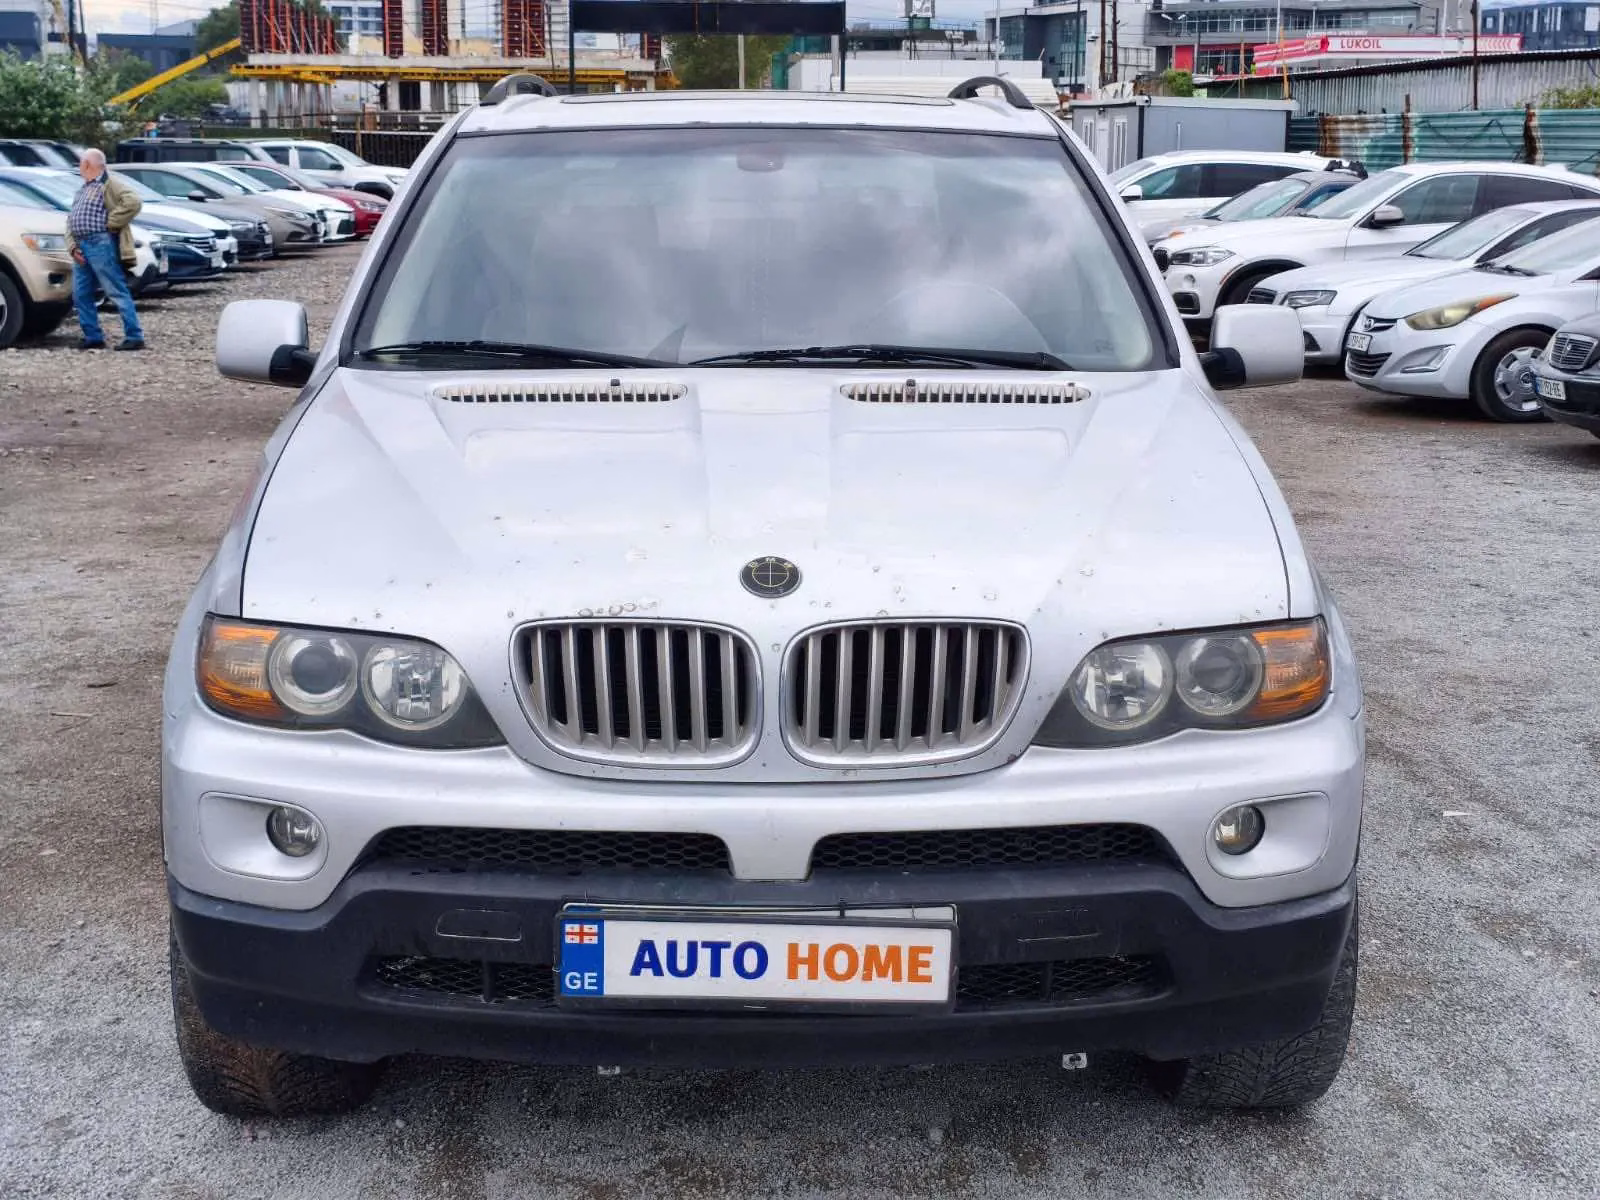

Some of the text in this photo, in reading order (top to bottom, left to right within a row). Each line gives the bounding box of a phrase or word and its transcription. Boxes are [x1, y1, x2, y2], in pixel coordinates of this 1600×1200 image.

[1340, 38, 1382, 49] LUKOIL
[629, 939, 933, 983] AUTO HOME
[564, 971, 598, 991] GE
